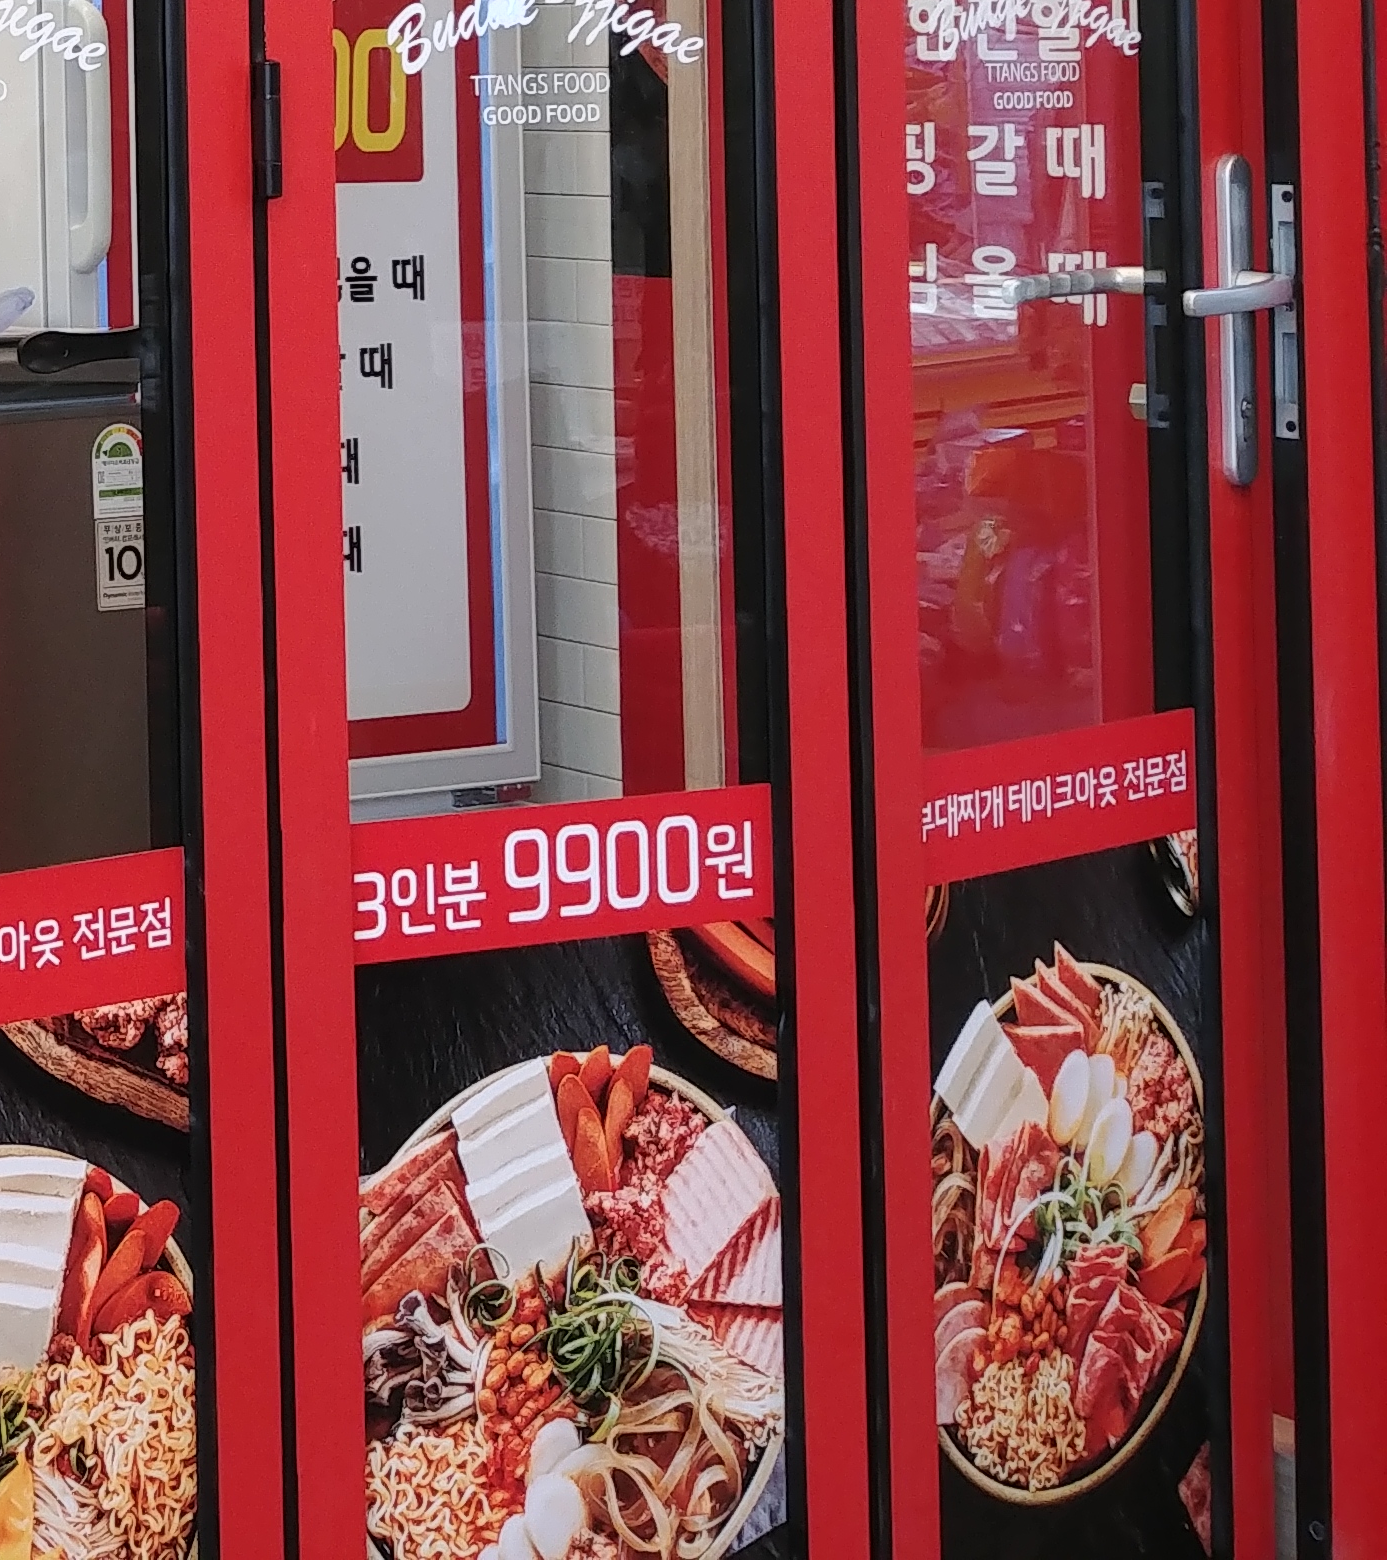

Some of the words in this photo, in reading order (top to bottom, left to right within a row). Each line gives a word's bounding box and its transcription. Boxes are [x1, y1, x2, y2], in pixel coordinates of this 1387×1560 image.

[469, 73, 549, 98] TTANGS
[552, 72, 610, 94] FOOD
[984, 61, 1039, 83] TTANGS
[1040, 60, 1080, 83] FOOD
[482, 104, 542, 127] GOOD
[545, 102, 601, 125] FOOD
[993, 90, 1034, 111] GOOD
[1036, 89, 1074, 110] FOOD
[966, 122, 1025, 197] 갈
[1045, 123, 1107, 200] 때
[391, 254, 425, 301] 때
[359, 342, 393, 390] 때
[1008, 766, 1119, 824] 테이크아웃
[1123, 749, 1187, 802] 전문점
[352, 859, 487, 942] 3인분
[503, 814, 755, 924] 9900원
[71, 896, 173, 961] 전문점
